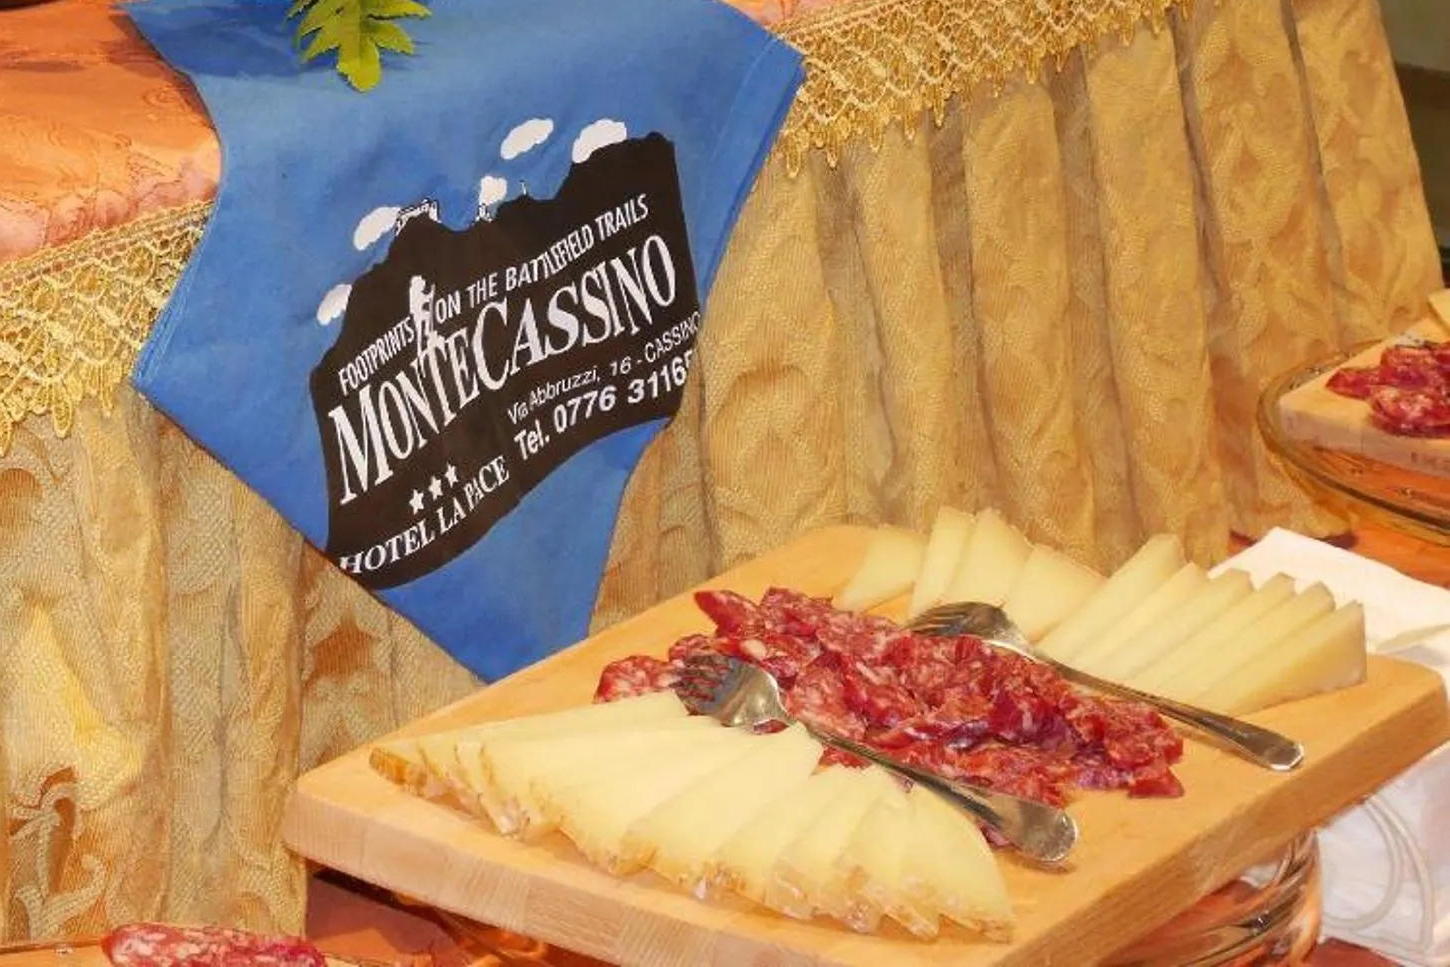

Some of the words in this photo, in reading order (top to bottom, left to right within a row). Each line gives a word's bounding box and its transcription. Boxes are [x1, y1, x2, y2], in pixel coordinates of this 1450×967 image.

[339, 317, 414, 396] FOOTPRINTS
[435, 290, 461, 324] ON
[467, 272, 498, 309] THE
[505, 224, 595, 292] BATTLEFIELD
[595, 193, 649, 241] TRAILS
[328, 234, 676, 506] MONTECASSINO
[514, 420, 550, 460] Tel.
[554, 386, 617, 433] 0776
[529, 365, 601, 410] Abbruzzi,
[609, 356, 631, 376] 16
[339, 521, 436, 575] HOTEL
[436, 499, 467, 533] LA
[465, 456, 510, 512] PACE
